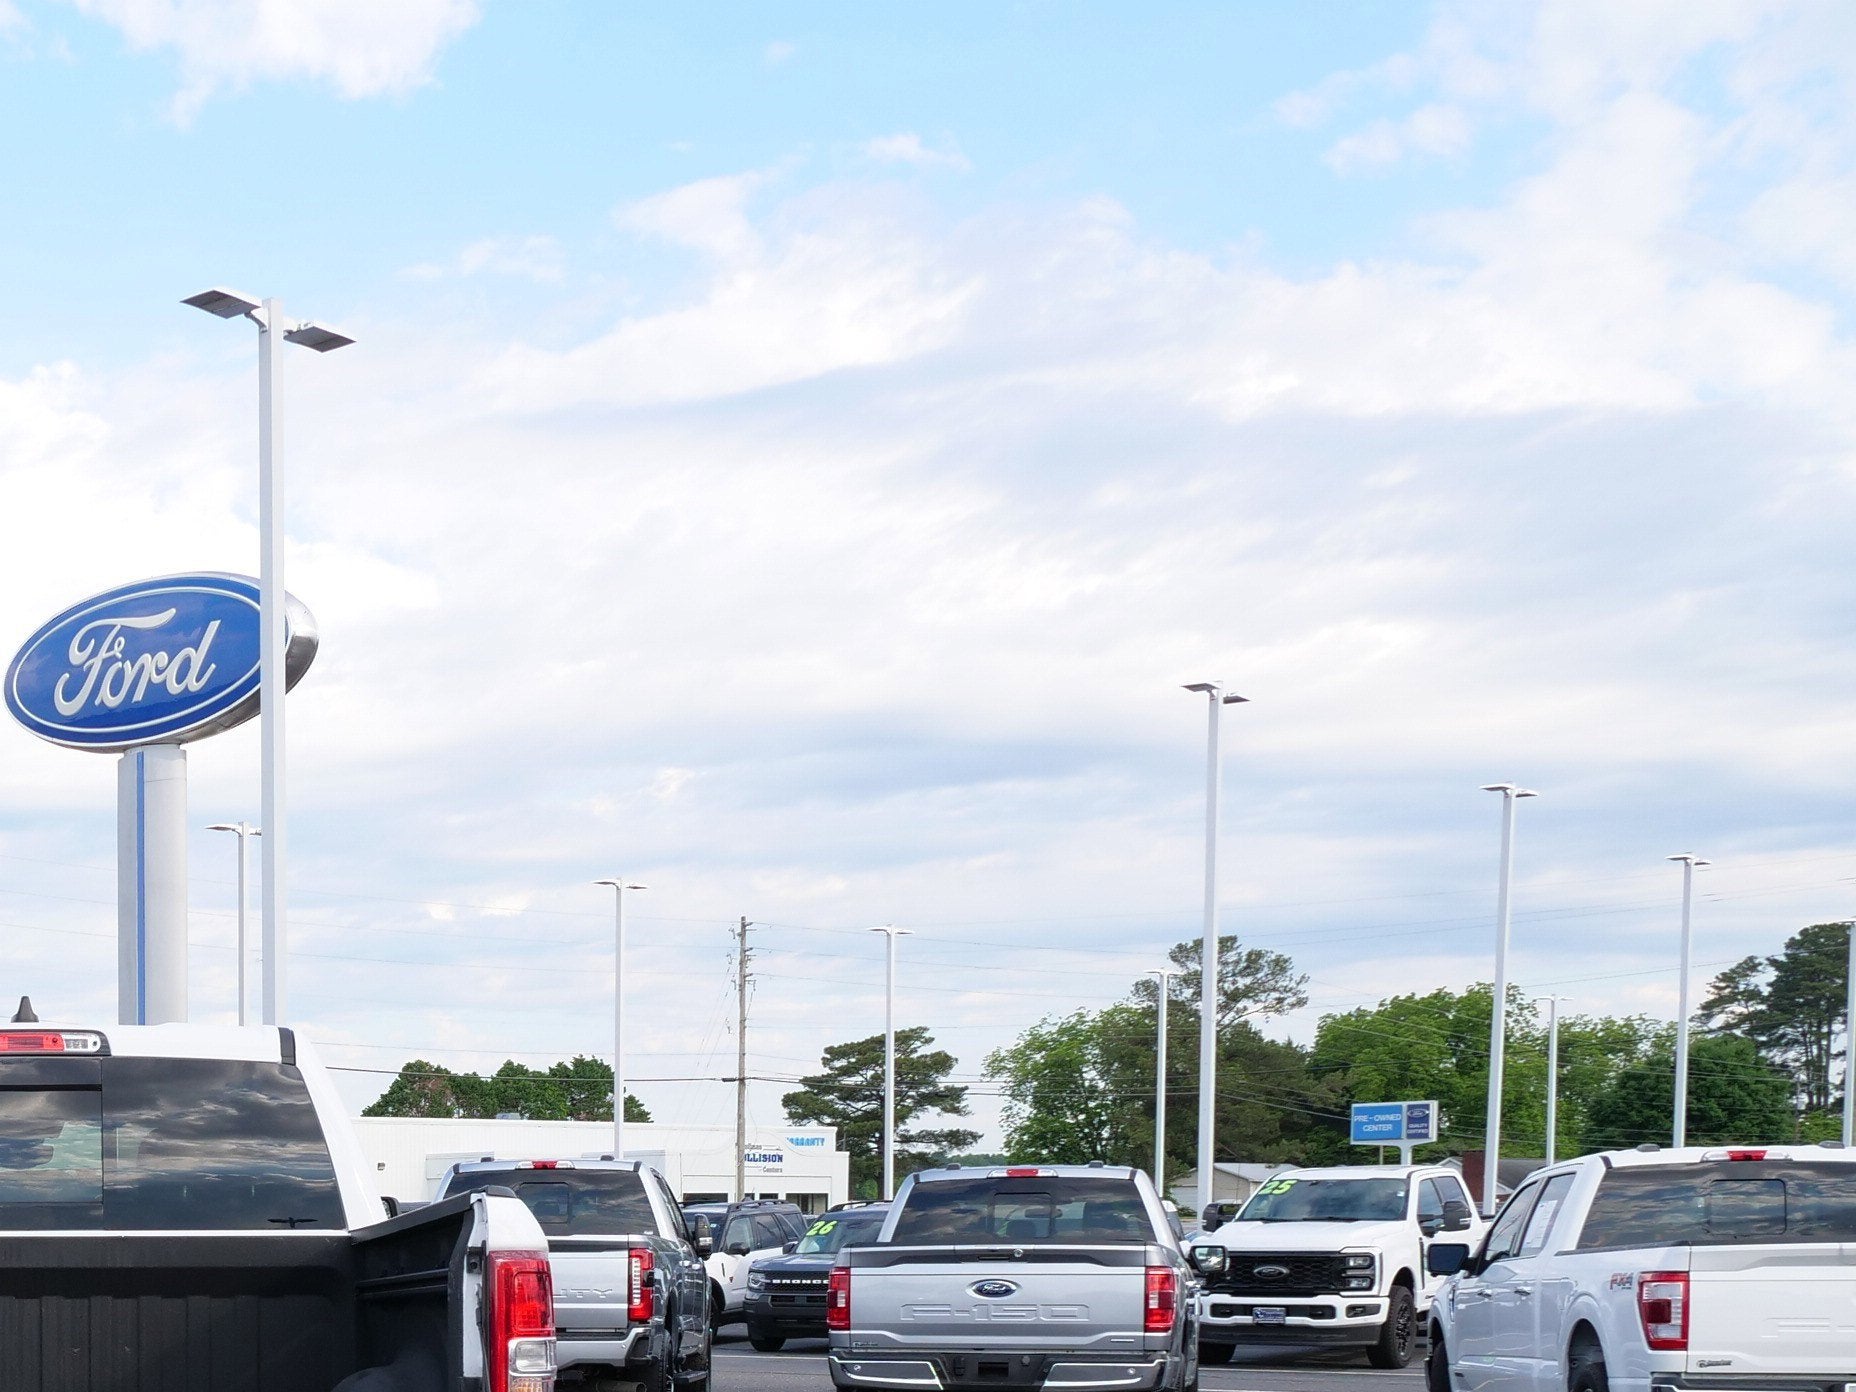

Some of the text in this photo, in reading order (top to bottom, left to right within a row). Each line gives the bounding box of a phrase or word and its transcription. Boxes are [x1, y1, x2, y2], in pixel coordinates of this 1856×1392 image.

[54, 607, 222, 717] Ford
[744, 1153, 784, 1163] LLISION
[1257, 1180, 1298, 1195] 25
[806, 1221, 838, 1236] 26
[900, 1303, 1090, 1321] F-150
